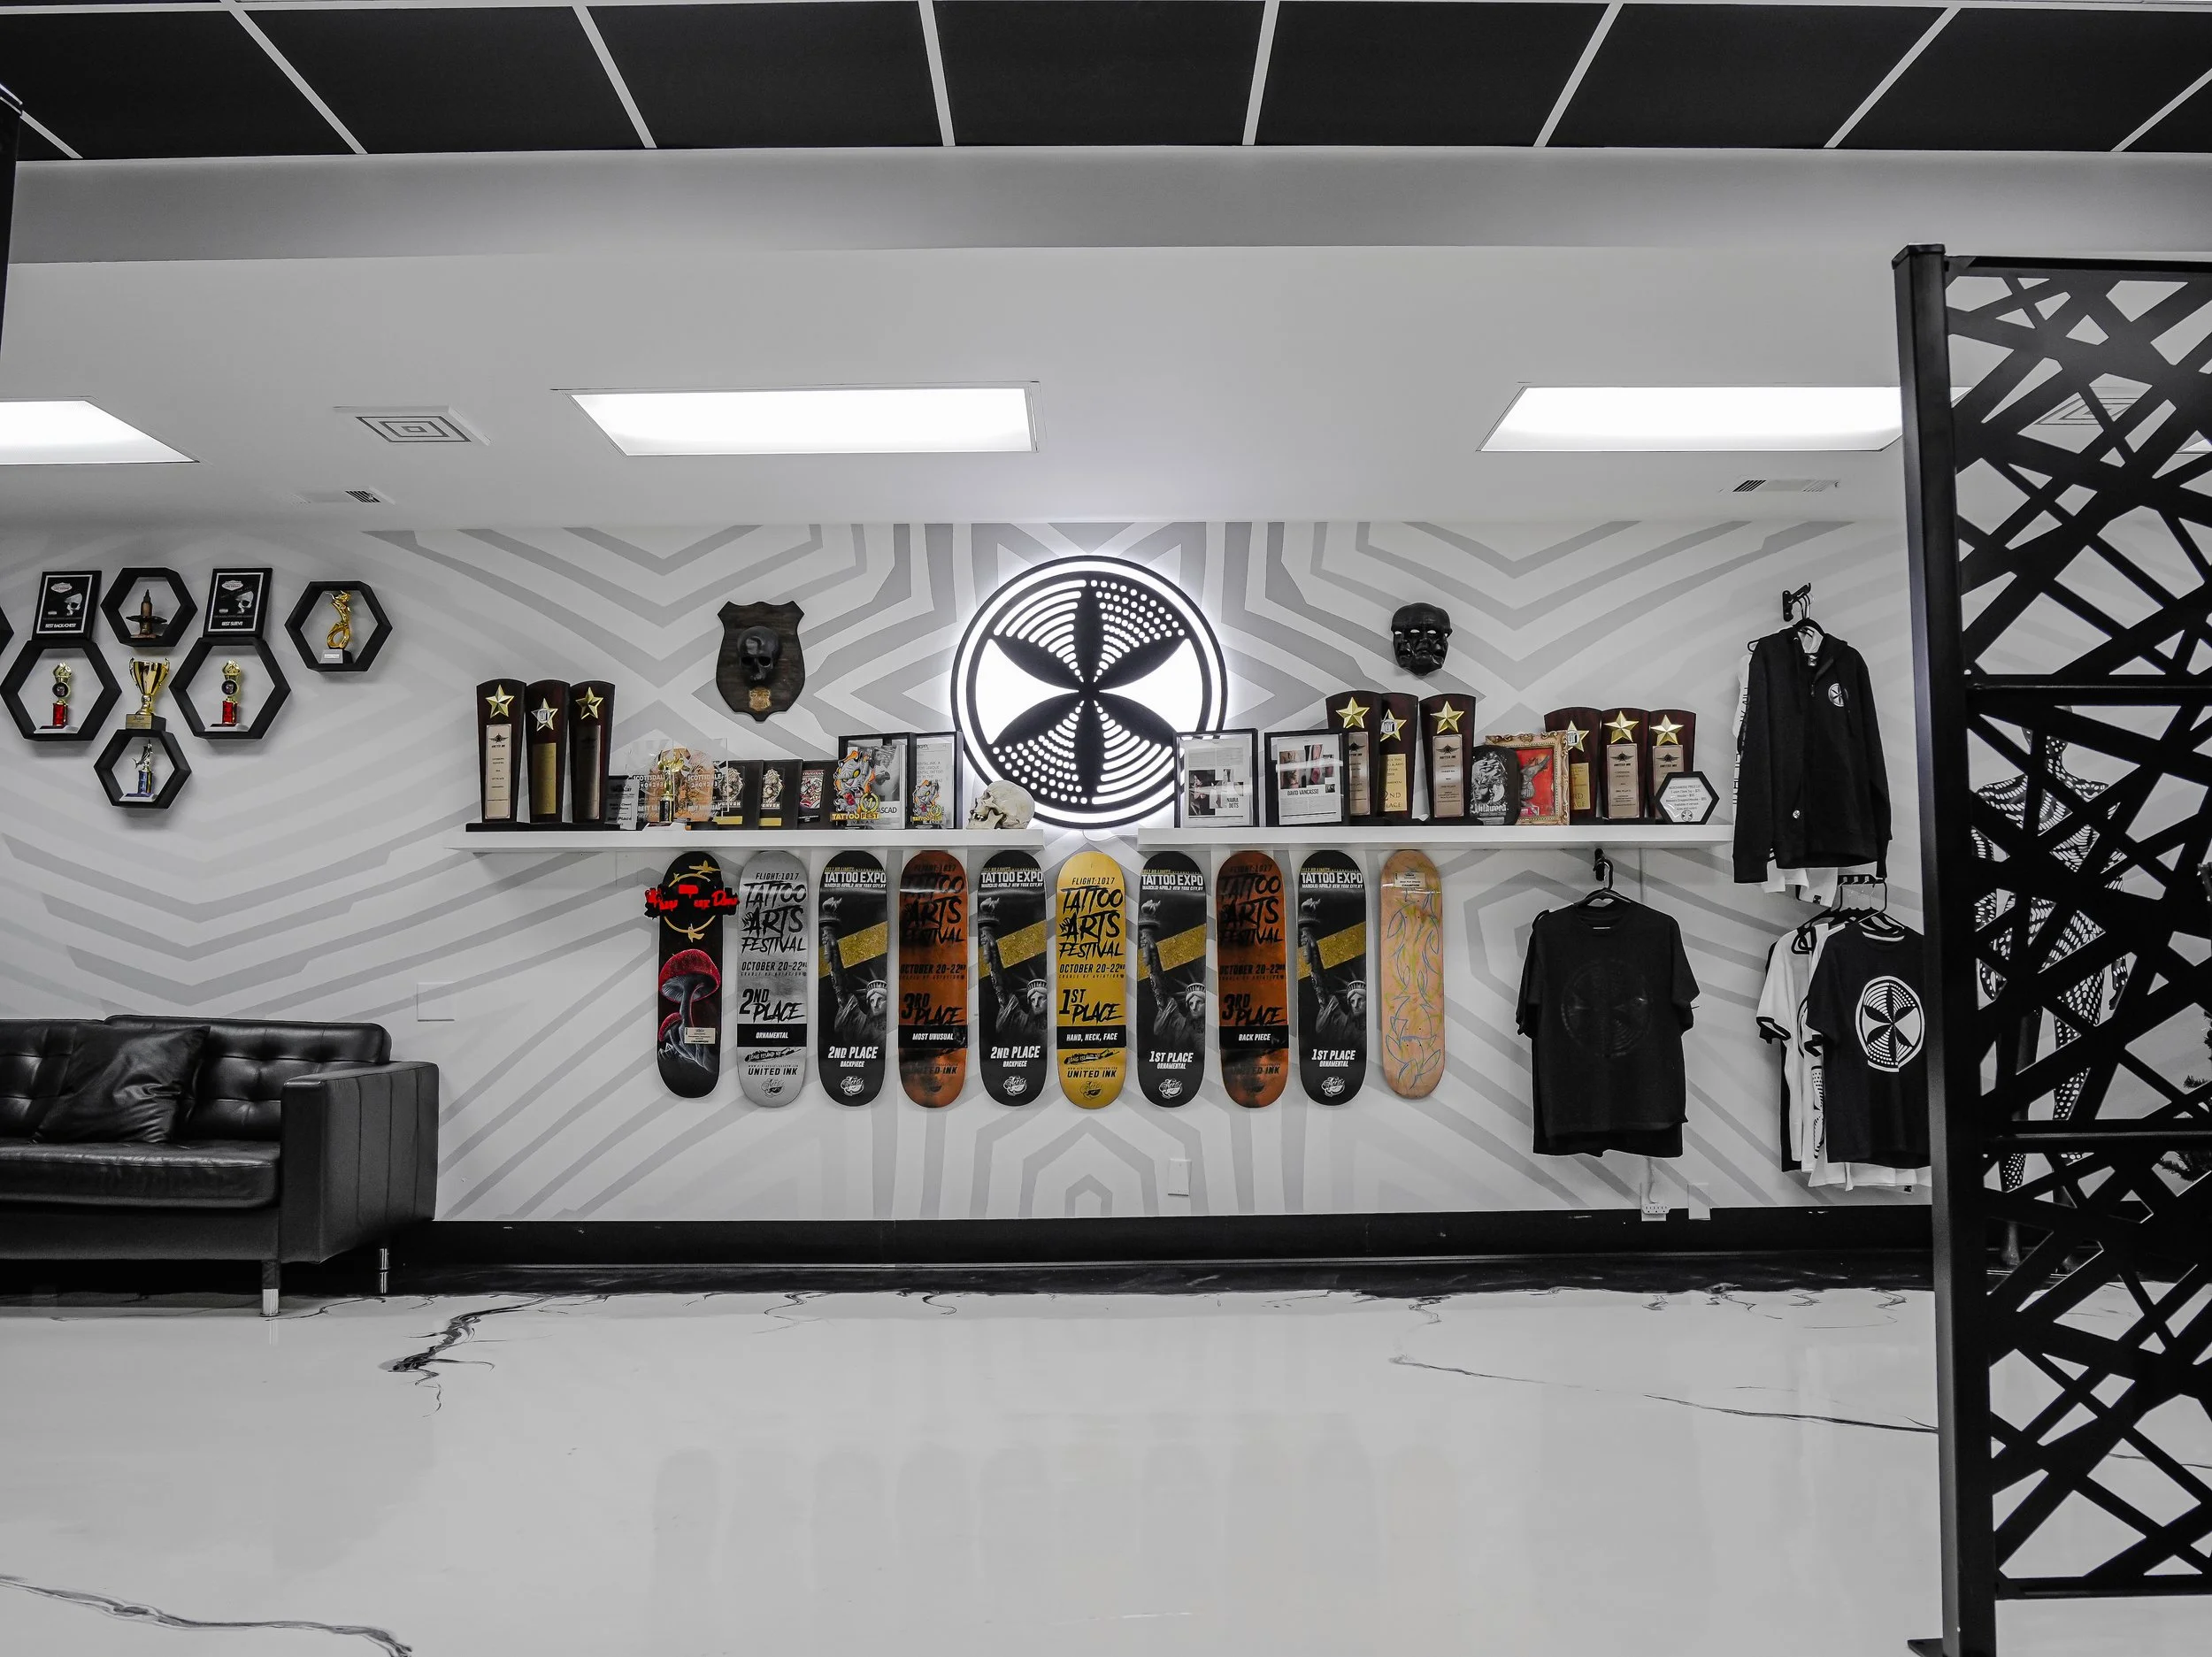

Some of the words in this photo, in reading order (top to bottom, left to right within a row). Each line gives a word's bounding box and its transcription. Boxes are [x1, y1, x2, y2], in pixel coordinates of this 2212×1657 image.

[824, 871, 858, 883] TATTOO
[859, 871, 887, 884] EXPO
[980, 871, 1016, 884] TATTOO
[1017, 871, 1043, 883] EXPO
[1141, 874, 1176, 886] TATTOO
[1177, 874, 1203, 886] EXPO
[1301, 872, 1336, 884] TATTOO
[1337, 872, 1363, 884] EXPO
[743, 880, 807, 909] TATTOO
[1061, 885, 1124, 915] TATTOO
[741, 904, 804, 938] ARTS
[1059, 909, 1121, 943] ARTS
[741, 934, 807, 955] FESTIVAL
[1059, 939, 1125, 961] FESTIVAL
[741, 961, 776, 971] OCTOBER
[1059, 963, 1094, 973] OCTOBER
[739, 988, 770, 1015] 2ND
[752, 1000, 806, 1023] PLACE
[902, 993, 930, 1020] 3RD
[1058, 988, 1087, 1015] 1ST
[1221, 993, 1250, 1021] 3RD
[914, 1005, 965, 1025] PLACE
[1071, 1001, 1125, 1025] PLACE
[1234, 1005, 1286, 1025] PLACE
[1066, 1033, 1084, 1042] HAND,
[1084, 1033, 1102, 1042] NECK,
[827, 1046, 848, 1059] 2ND
[849, 1046, 879, 1059] PLACE
[990, 1046, 1010, 1059] 2ND
[1010, 1045, 1041, 1059] PLACE
[1148, 1050, 1167, 1062] 1ST
[1167, 1052, 1194, 1062] PLACE
[1311, 1048, 1329, 1061] 1ST
[1329, 1049, 1356, 1061] PLACE
[782, 1067, 798, 1076] INK
